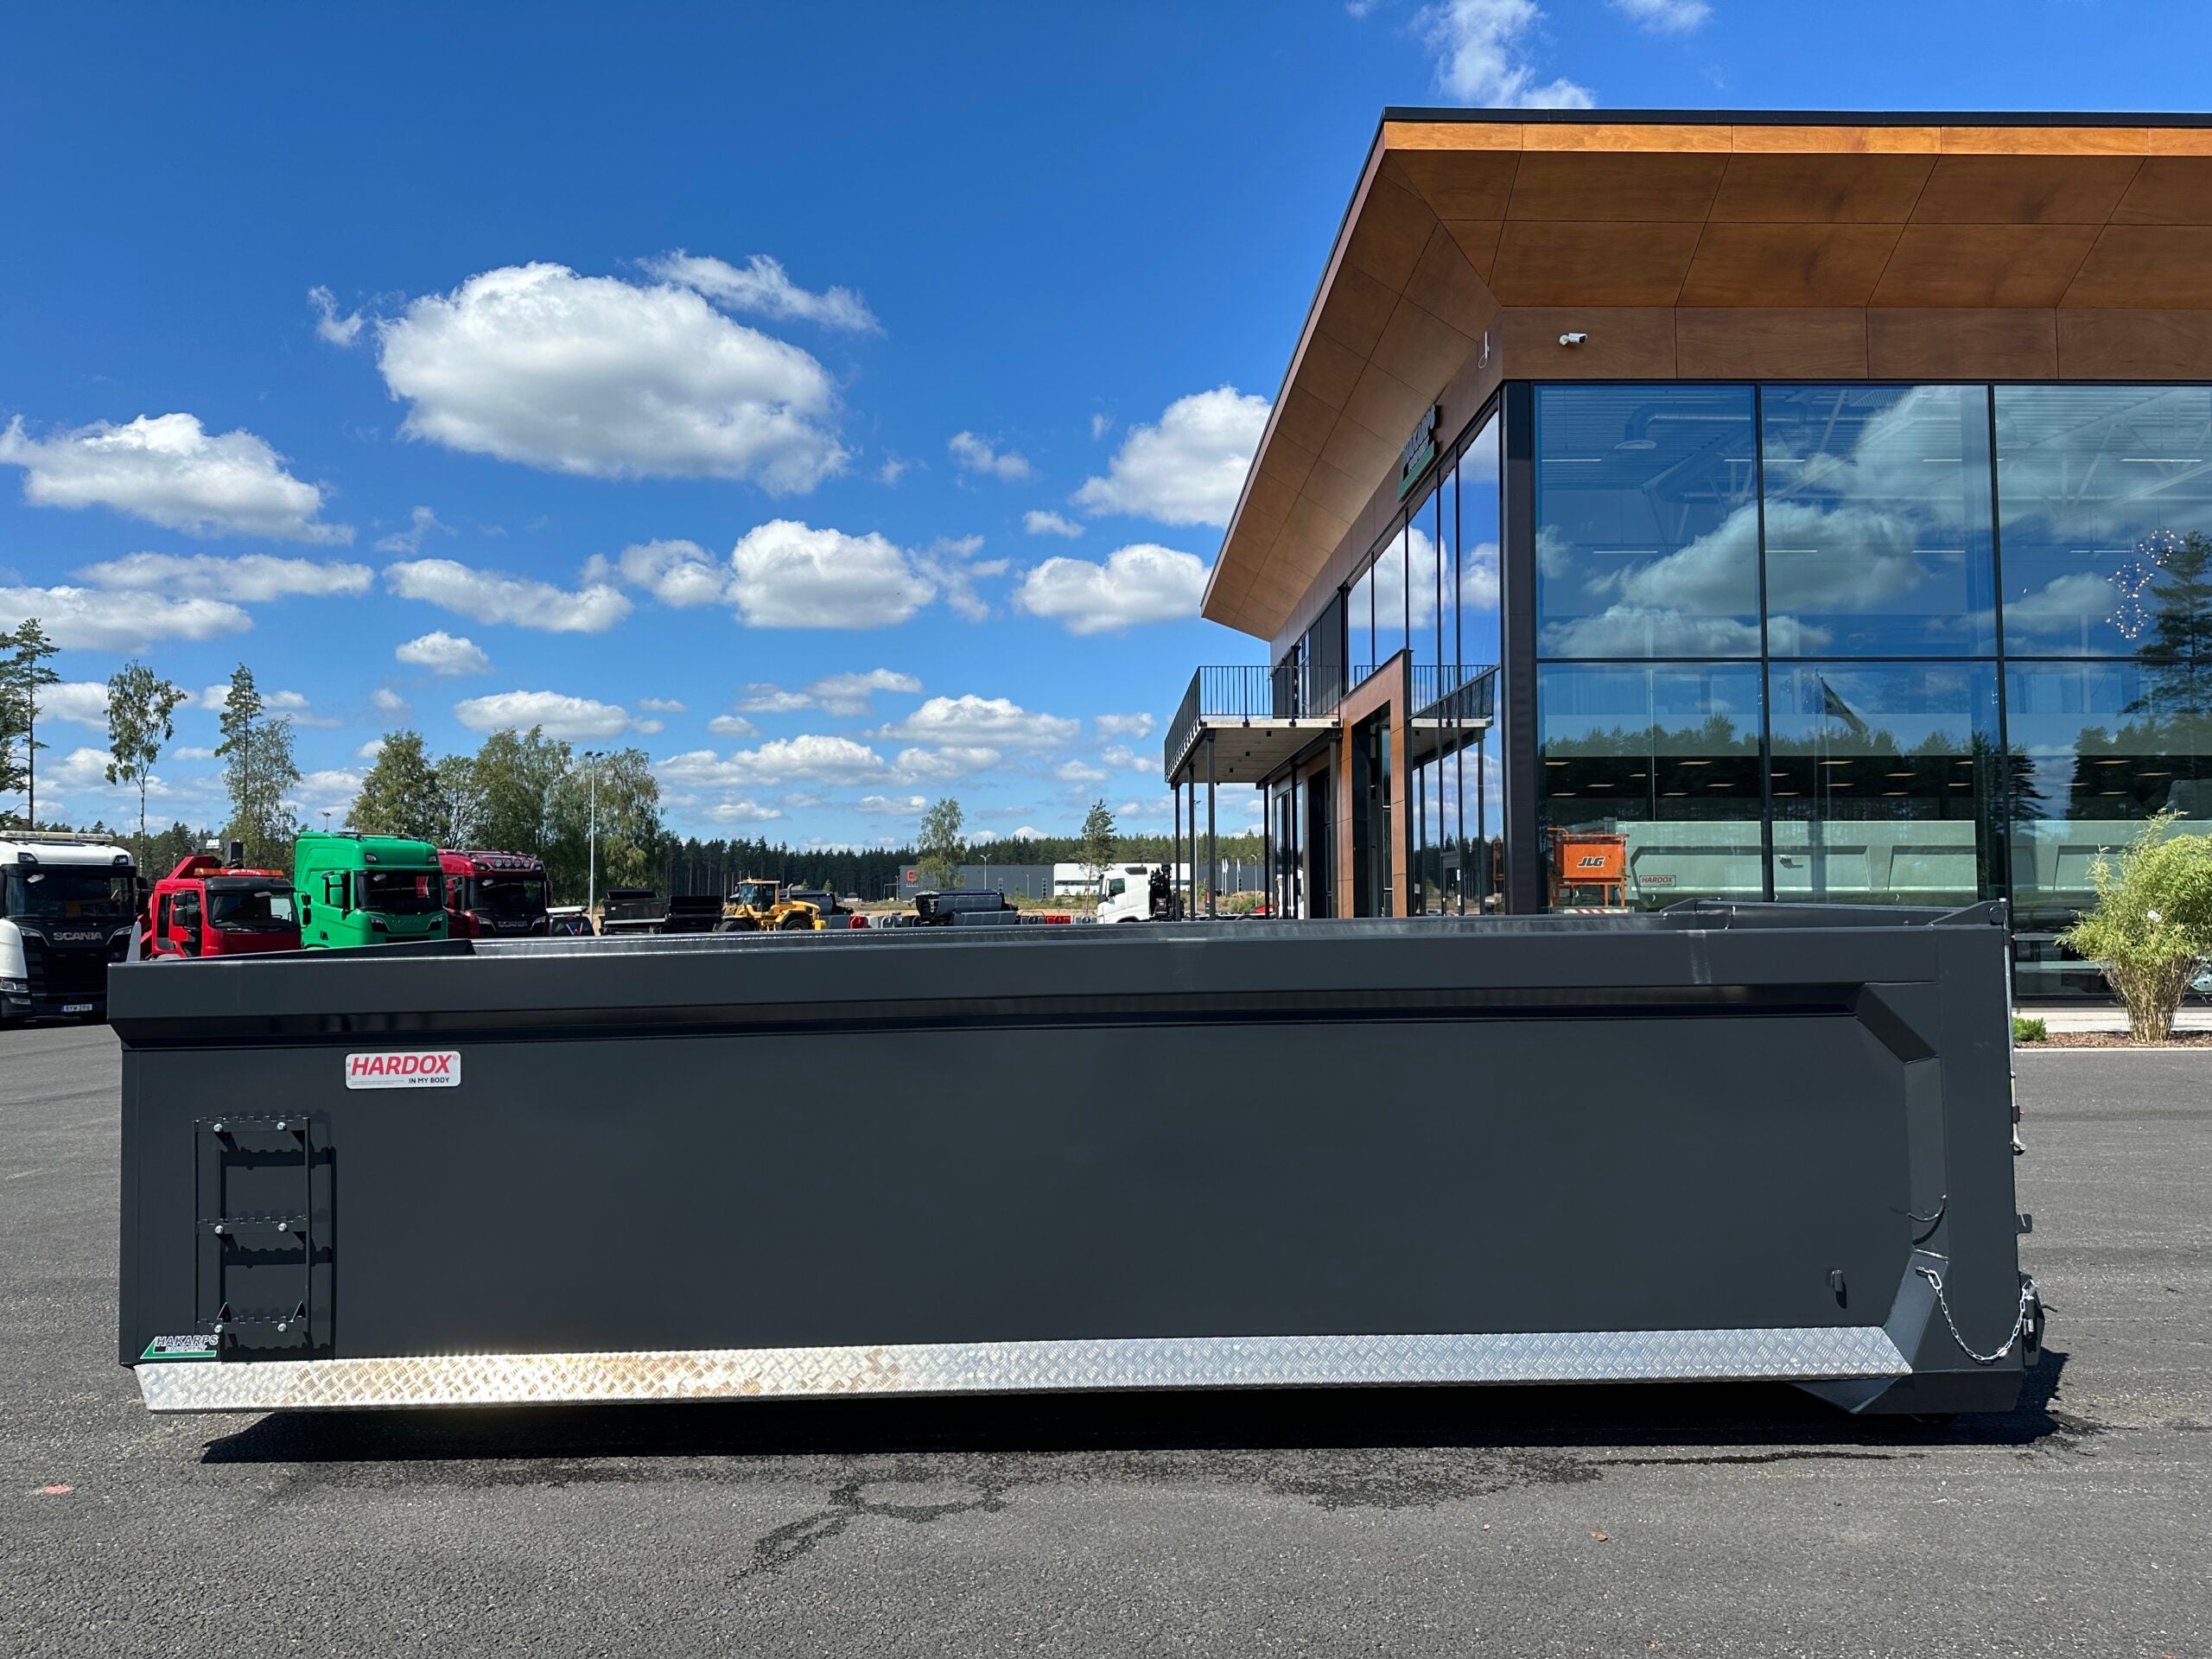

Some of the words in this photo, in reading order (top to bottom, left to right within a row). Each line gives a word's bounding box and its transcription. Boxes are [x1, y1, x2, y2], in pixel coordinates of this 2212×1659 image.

[1577, 856, 1605, 868] JLG
[53, 931, 103, 941] SCANIA
[351, 1055, 453, 1076] HARDOX
[156, 1334, 219, 1347] HAKARPS
